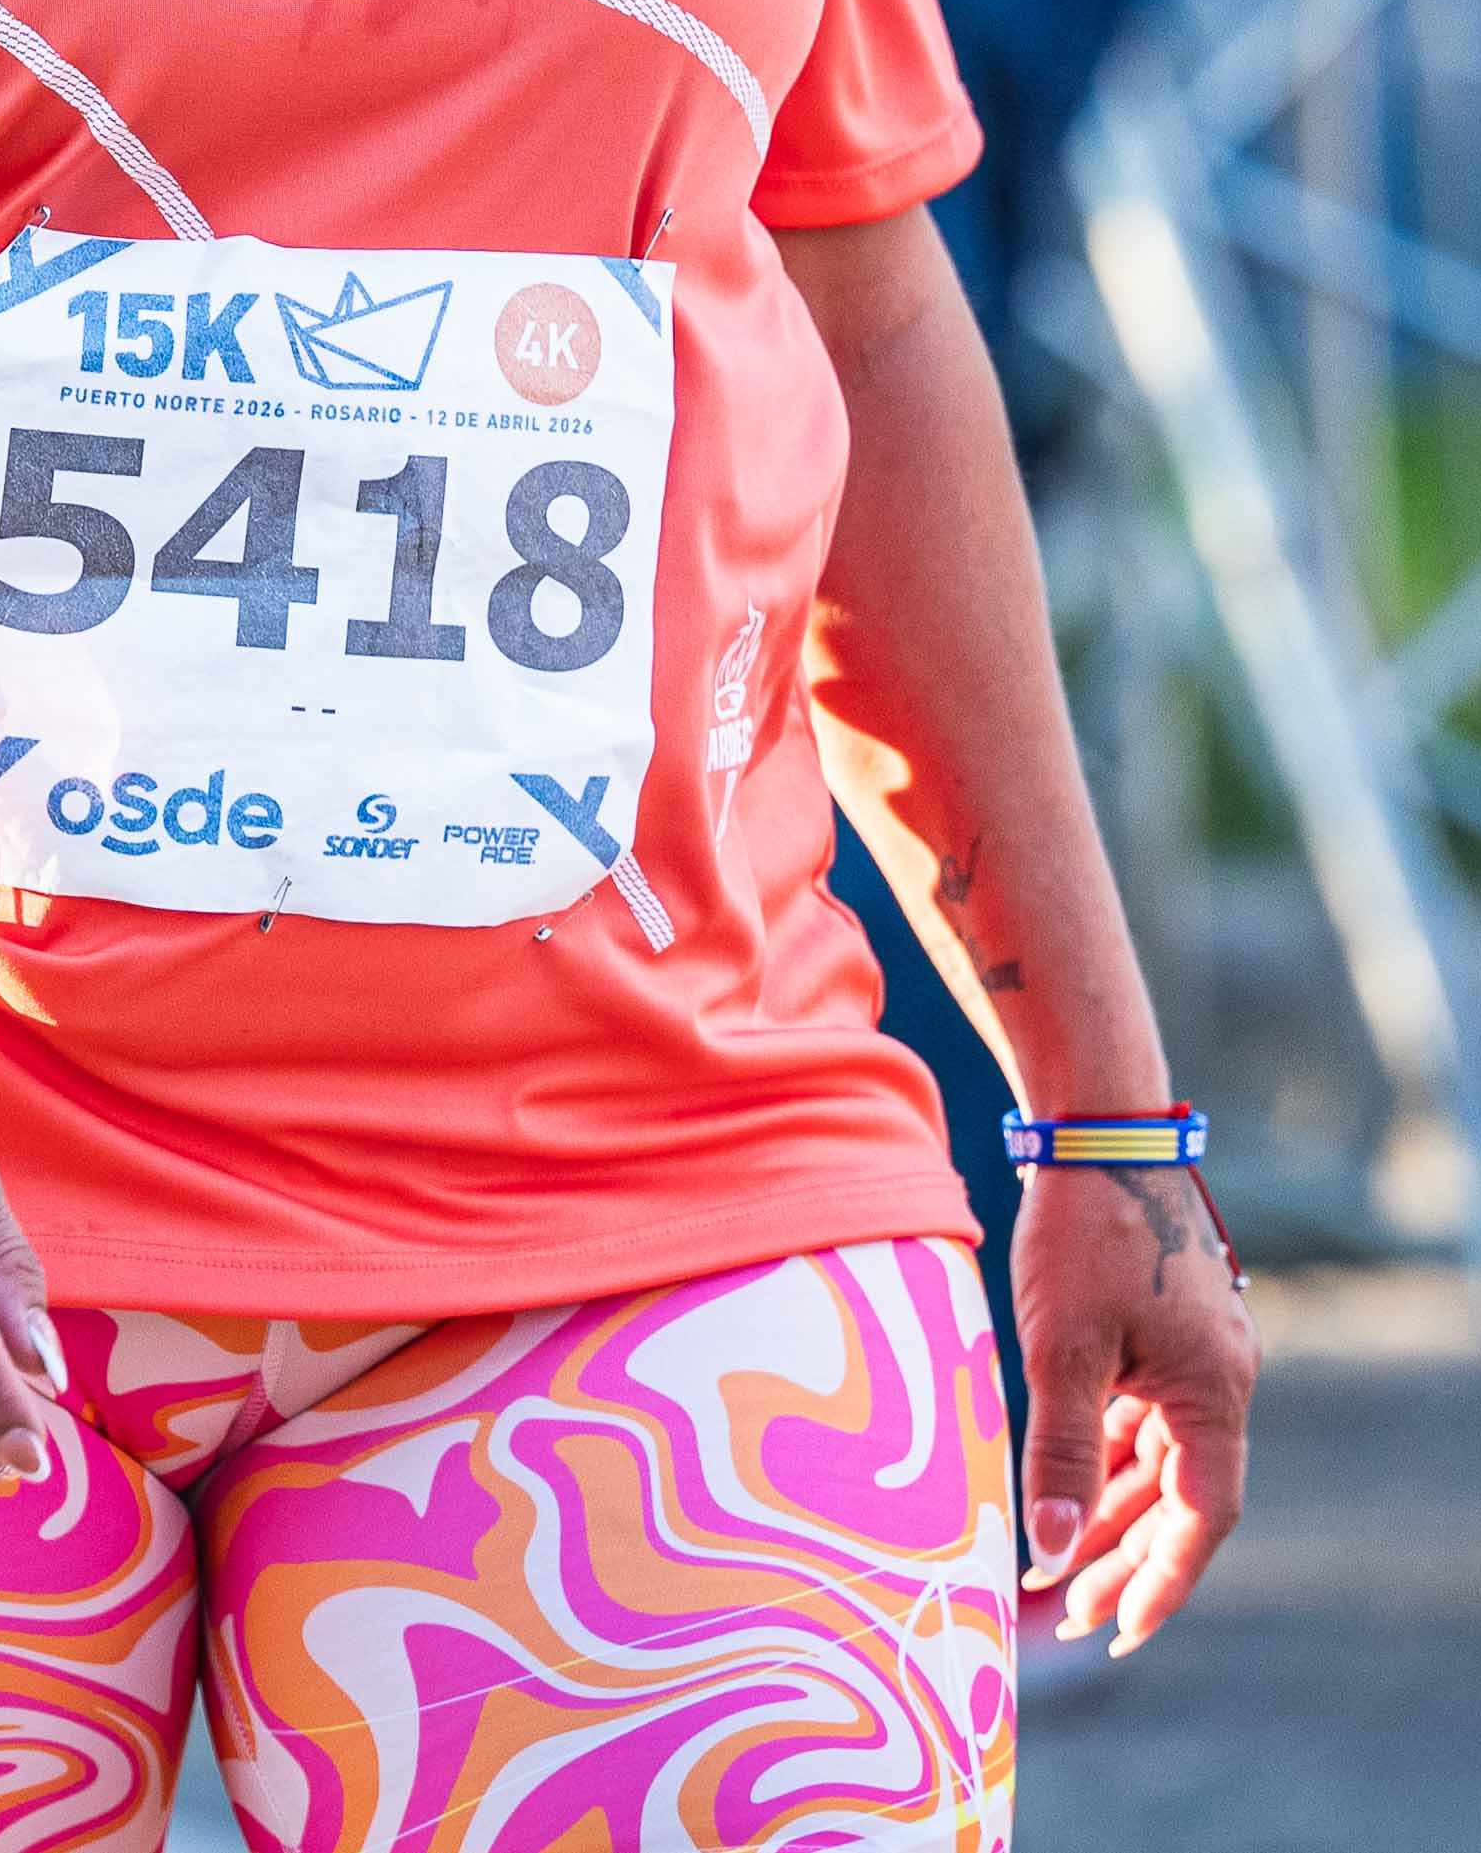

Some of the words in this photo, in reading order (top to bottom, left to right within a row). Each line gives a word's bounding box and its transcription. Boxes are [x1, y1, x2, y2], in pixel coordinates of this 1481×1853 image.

[67, 289, 261, 384] 15K
[513, 322, 580, 370] 4K
[60, 386, 145, 409] PUERTO
[154, 393, 225, 414] NORTE
[233, 399, 285, 418] 2026
[311, 403, 401, 424] ROSARIO
[427, 409, 447, 427] 12
[455, 411, 478, 428] DE
[486, 413, 540, 432] ABRIL
[548, 417, 594, 435] 2026
[46, 768, 284, 856] osde
[443, 824, 540, 846] POWER
